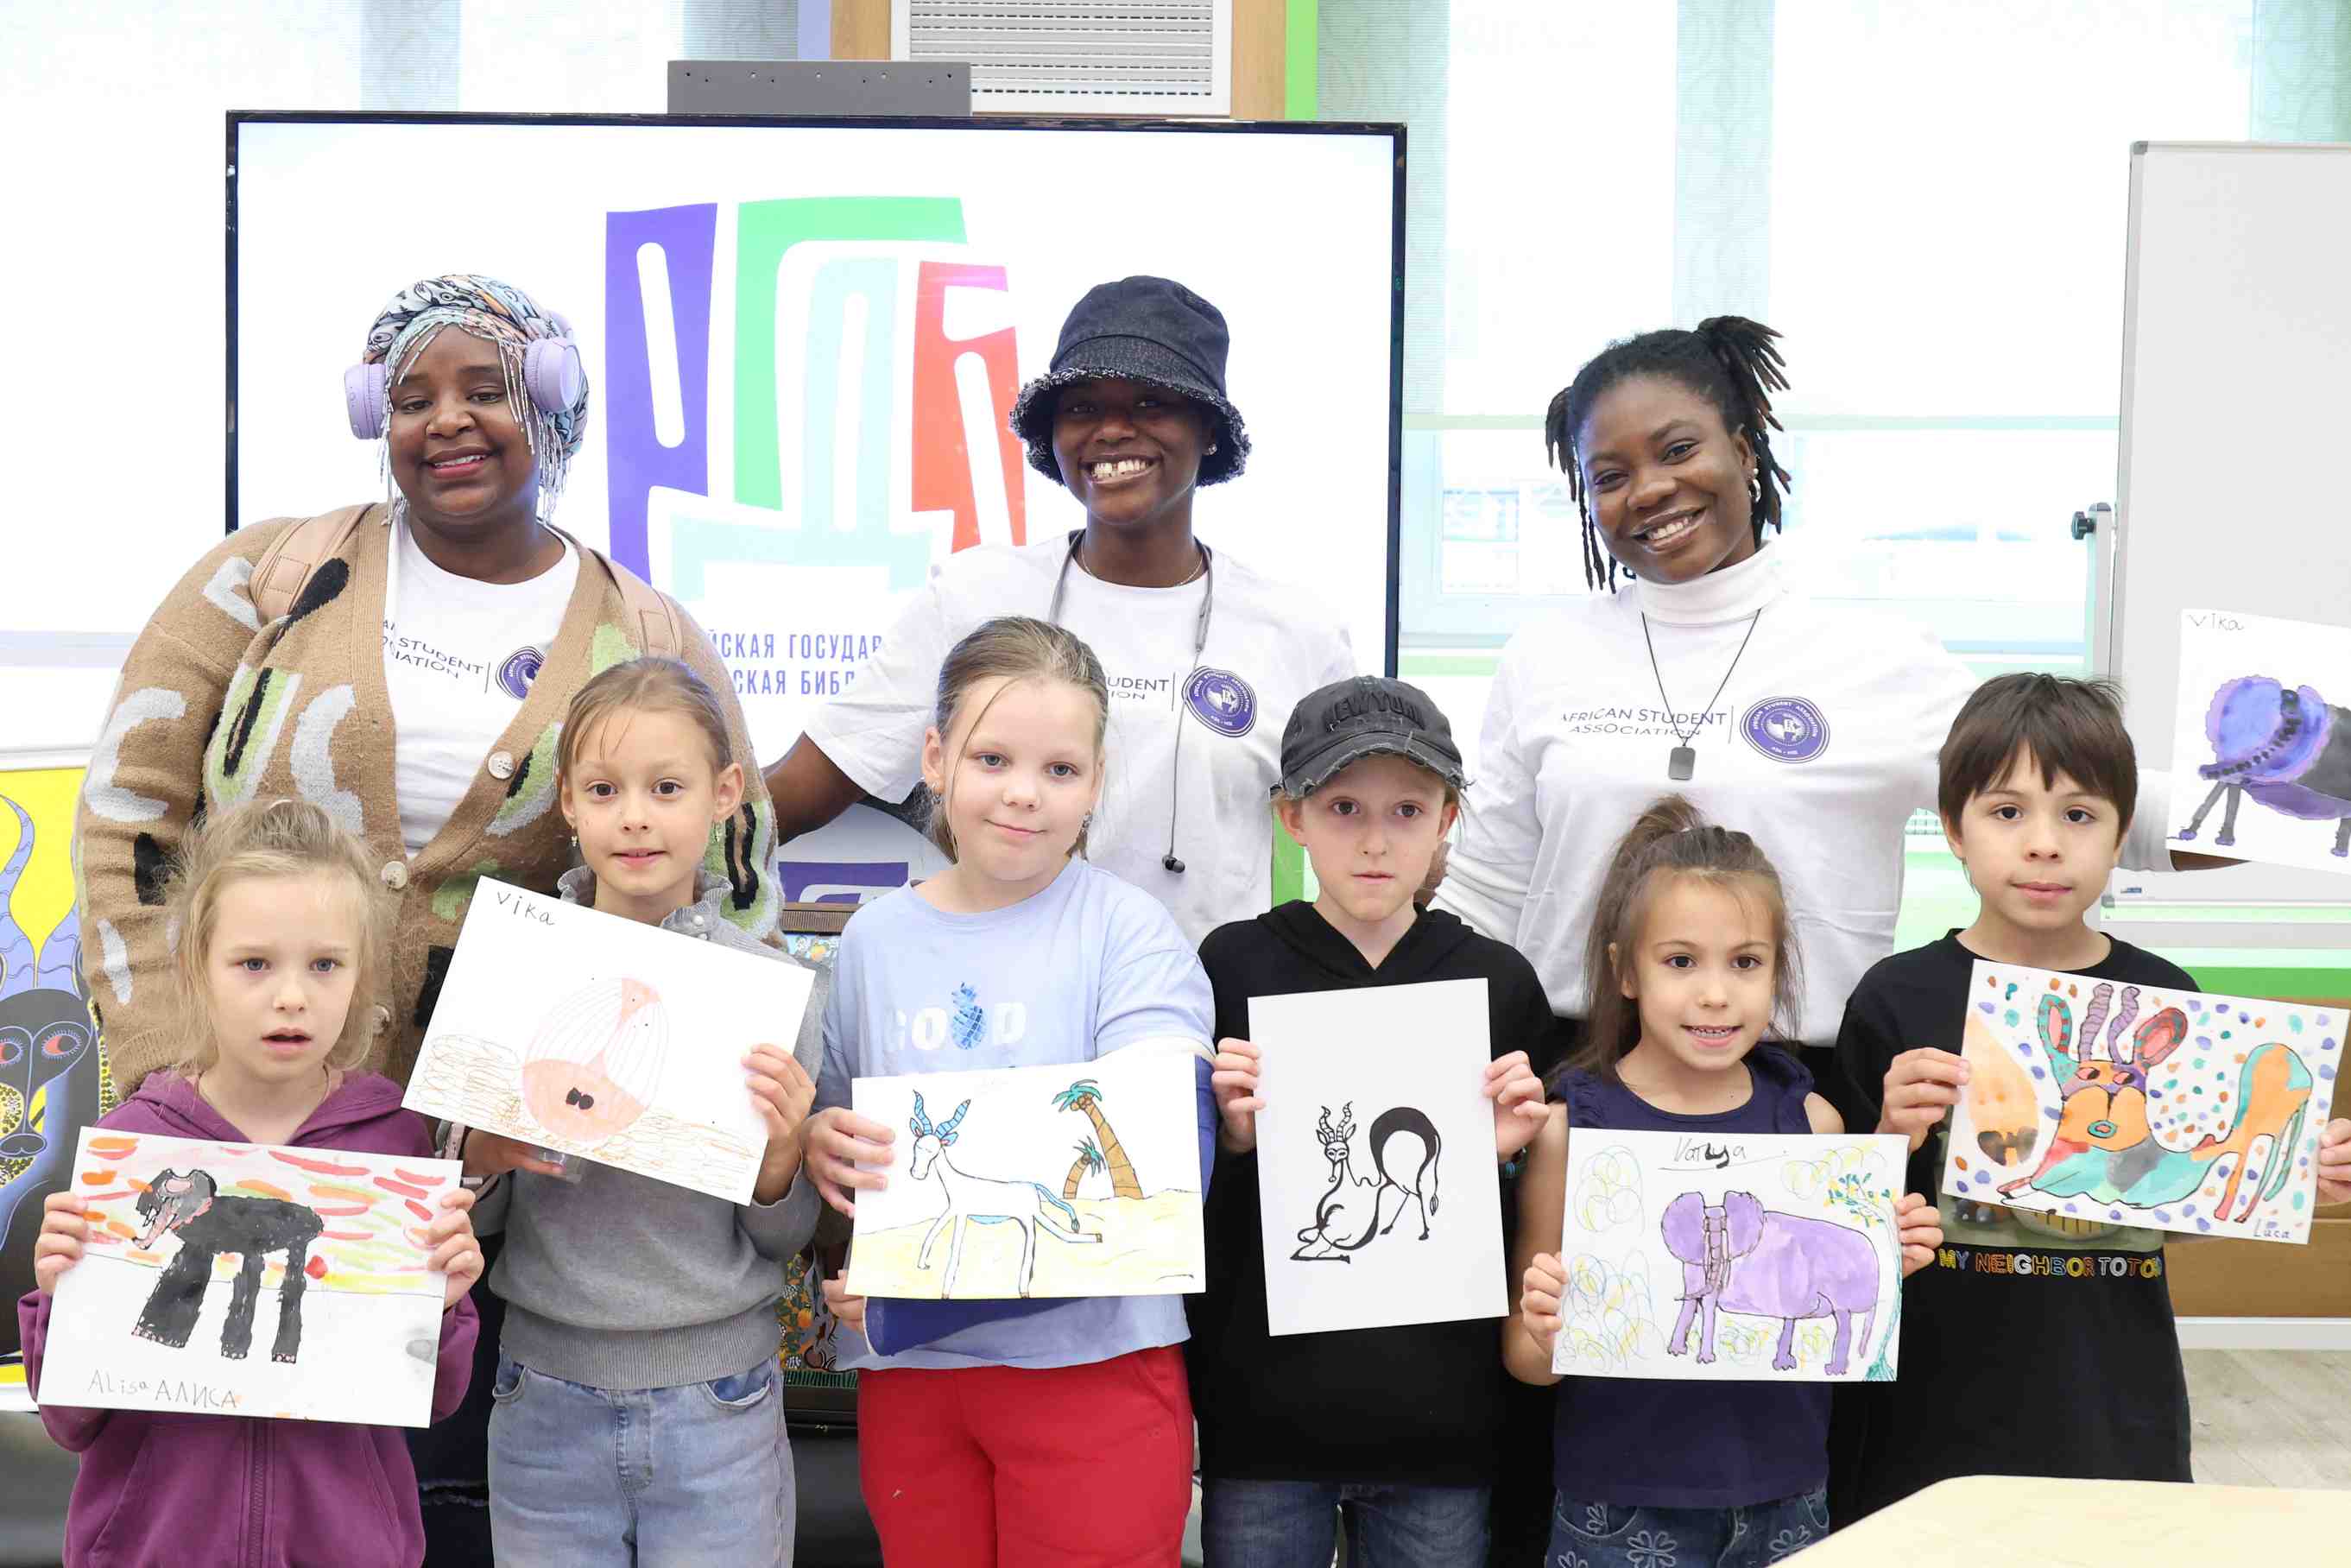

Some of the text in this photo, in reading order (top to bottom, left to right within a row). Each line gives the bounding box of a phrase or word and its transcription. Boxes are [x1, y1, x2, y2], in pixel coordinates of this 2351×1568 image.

[398, 637, 484, 674] STUDENT
[789, 634, 882, 663] ГОСУДАР
[734, 669, 787, 695] СКАЯ
[1107, 676, 1169, 692] UDENT
[1570, 723, 1701, 736] ASSOCIATION
[1638, 708, 1728, 725] STUDENT
[1938, 1248, 1969, 1270] MY
[1975, 1253, 2095, 1278] NEIGHBOR
[155, 1379, 237, 1409] АЛИСА
